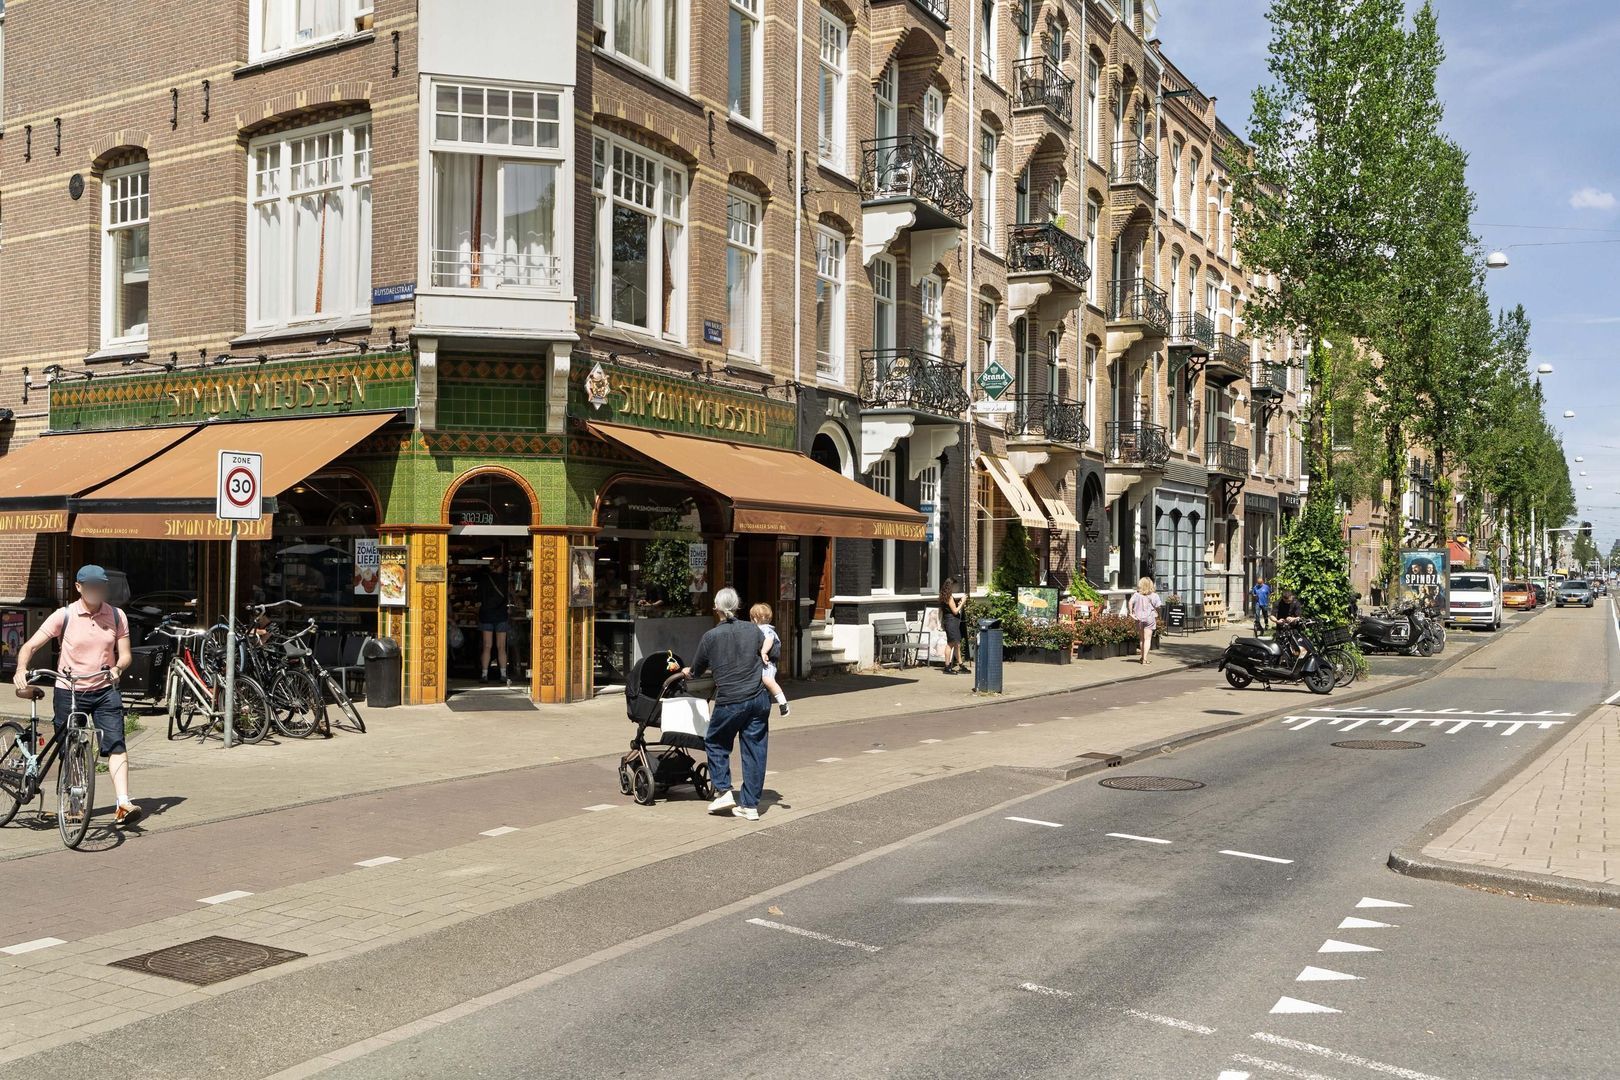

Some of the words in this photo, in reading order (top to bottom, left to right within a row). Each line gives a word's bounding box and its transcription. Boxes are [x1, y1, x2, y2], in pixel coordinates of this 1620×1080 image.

[982, 373, 1005, 381] Brand
[168, 384, 240, 417] SIMON
[619, 384, 683, 422] SIMON
[232, 479, 251, 493] 30
[164, 520, 204, 535] SIMON
[873, 522, 895, 535] SIMON
[1405, 574, 1441, 584] SPINOZA
